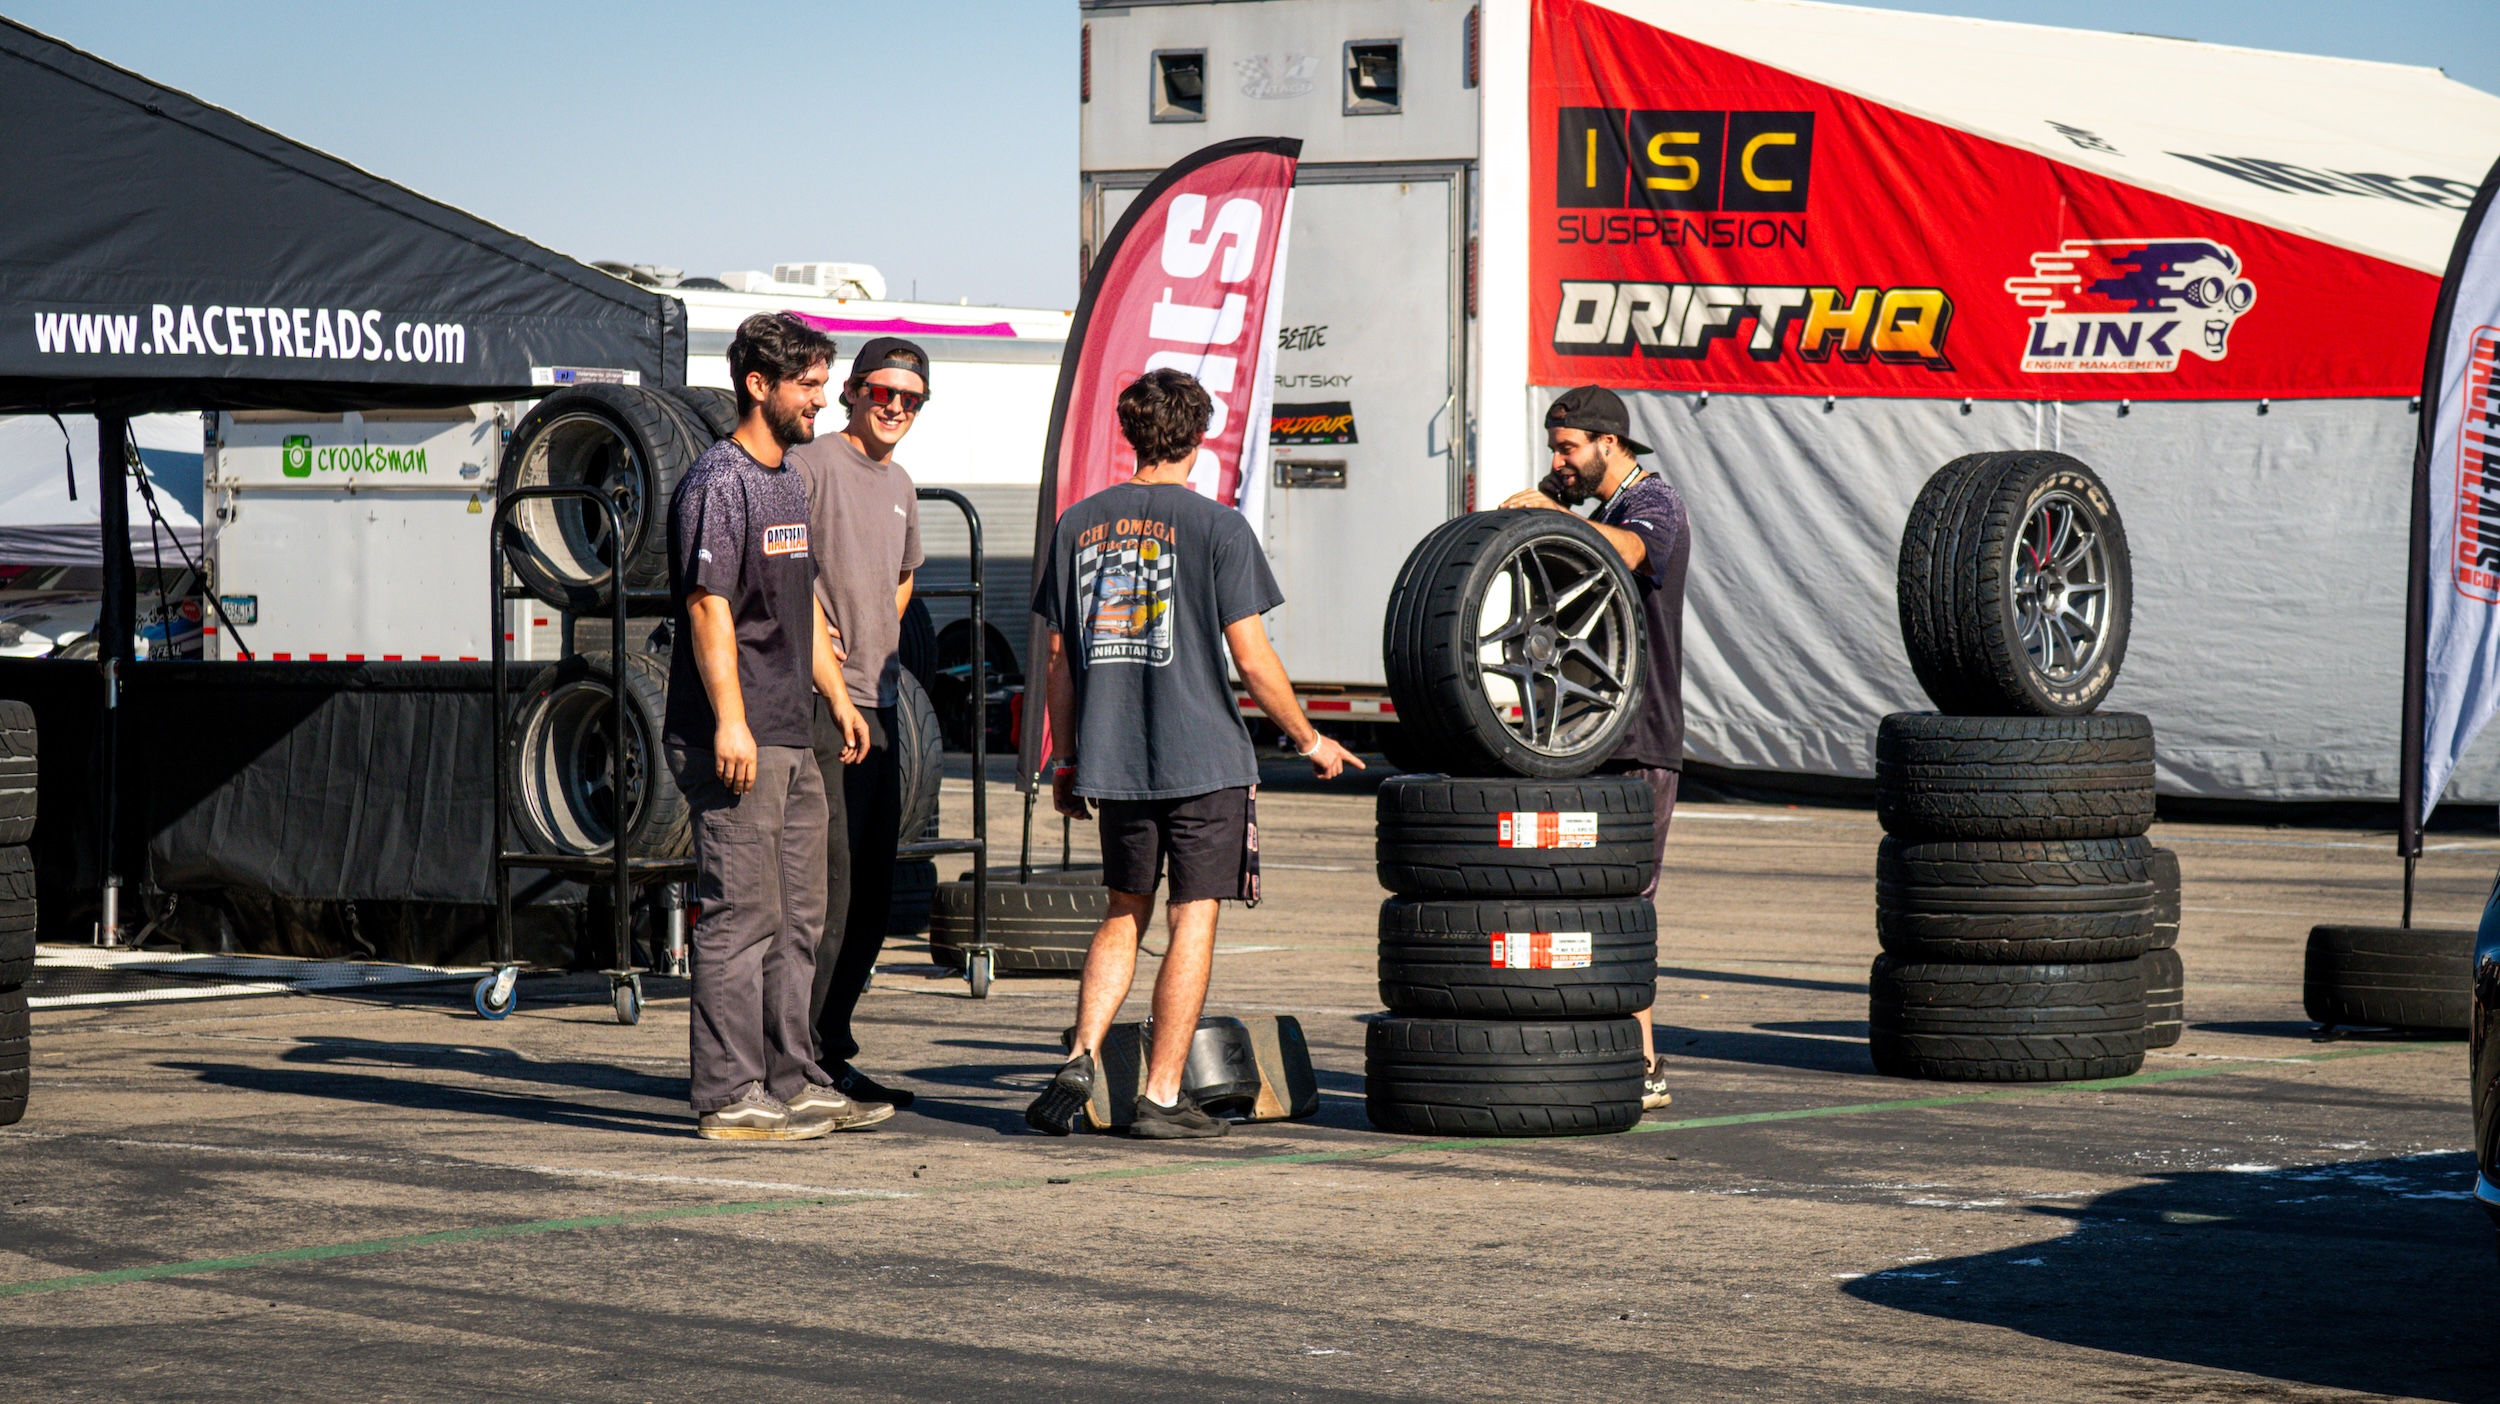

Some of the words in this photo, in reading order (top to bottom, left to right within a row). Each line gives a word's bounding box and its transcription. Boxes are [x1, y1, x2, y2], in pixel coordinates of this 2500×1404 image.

[1558, 215, 1806, 249] SUSPENSION
[34, 304, 466, 364] www.RACETREADS.com
[2028, 321, 2182, 357] LINK
[2025, 360, 2075, 370] ENGINE
[2079, 360, 2174, 371] MANAGEMENT
[318, 438, 428, 474] crooksman
[1079, 521, 1110, 548] CHI
[1116, 518, 1176, 546] OMEGA
[1090, 645, 1147, 658] ANHATTAN
